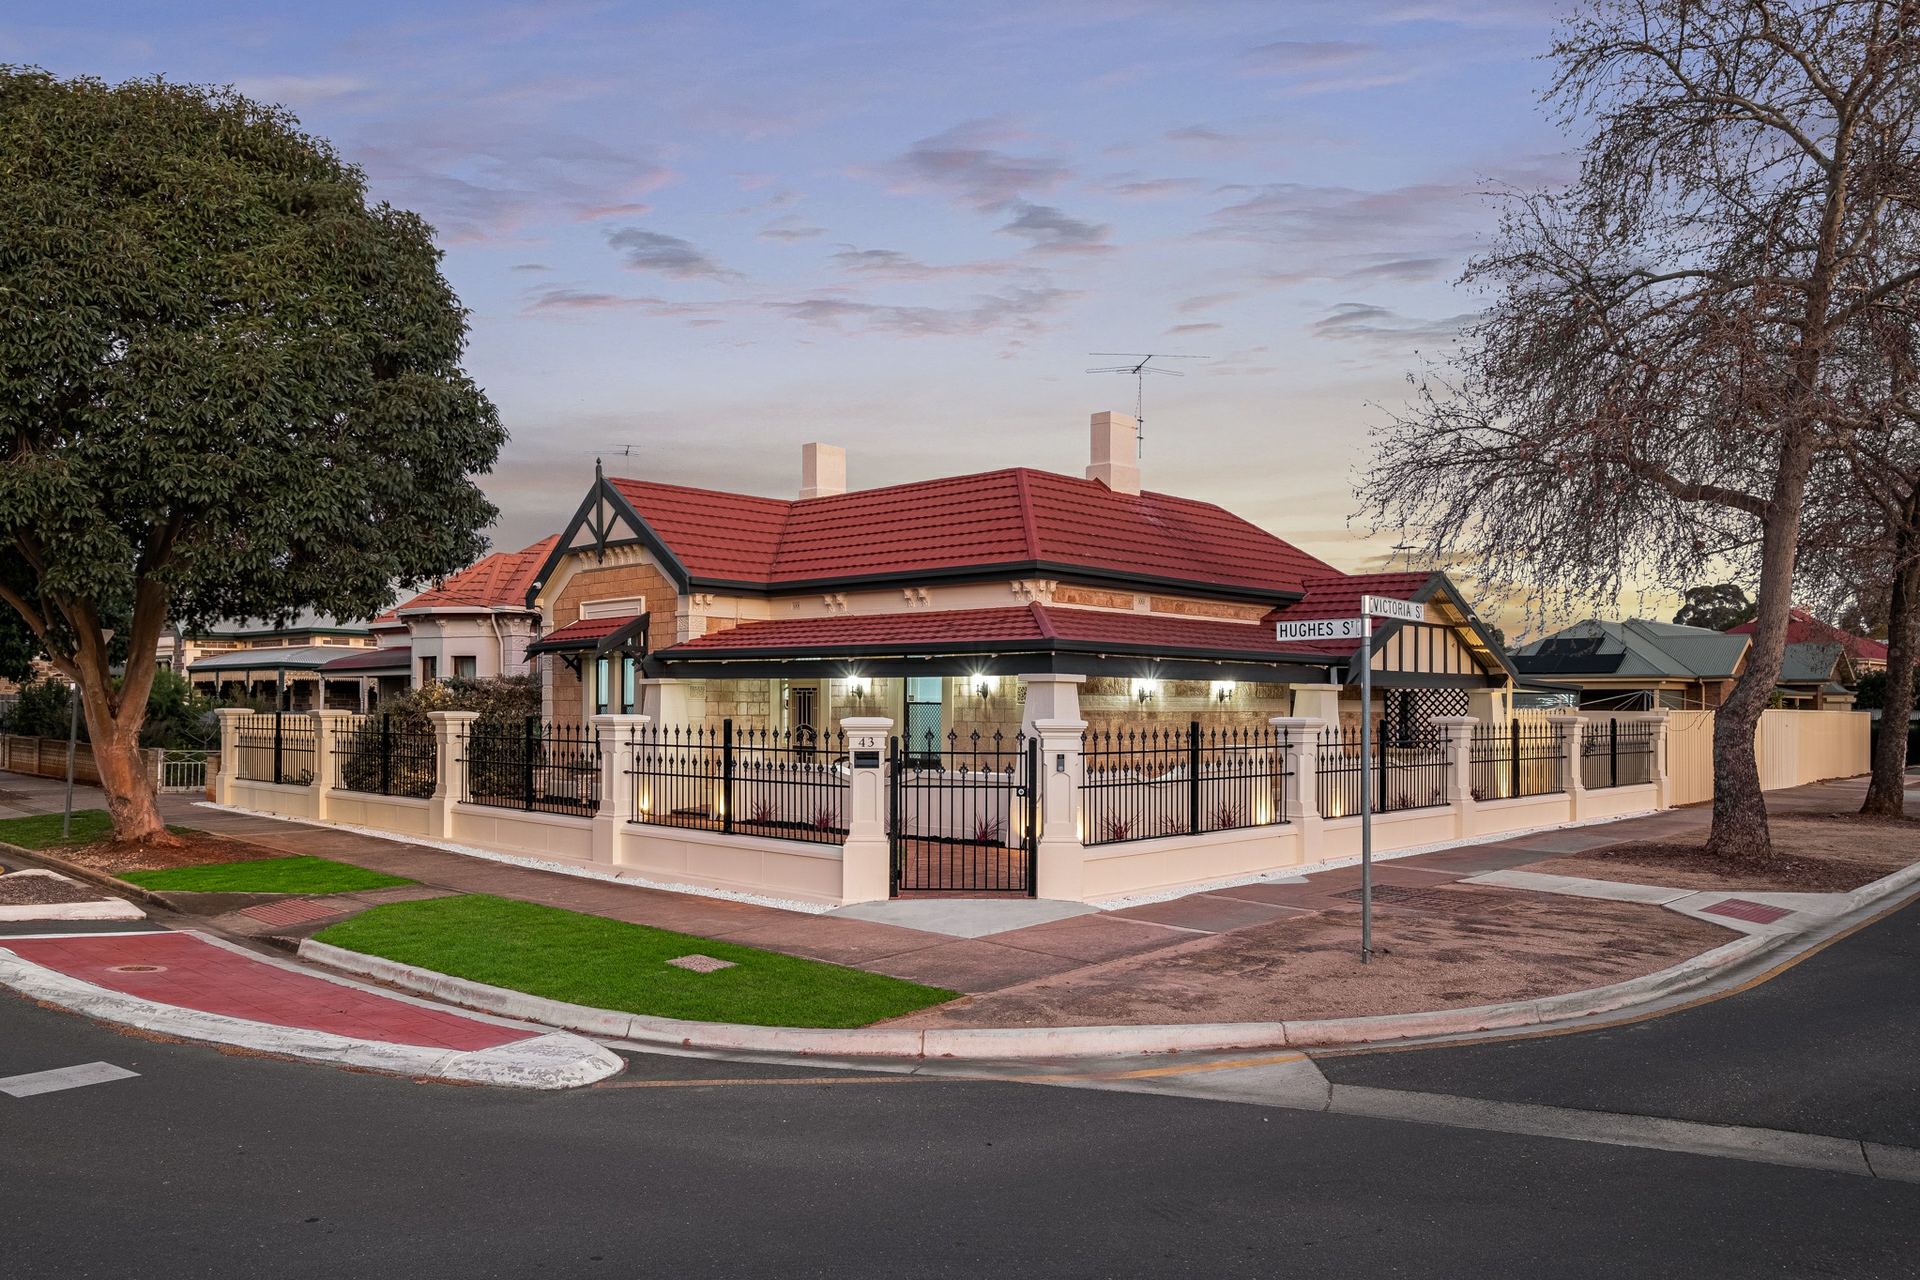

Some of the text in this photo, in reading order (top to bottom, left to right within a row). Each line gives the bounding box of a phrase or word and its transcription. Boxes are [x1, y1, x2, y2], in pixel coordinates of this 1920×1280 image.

[1374, 598, 1411, 617] VICTORIA
[1280, 620, 1354, 638] HUGHES ST
[858, 737, 875, 748] 43
